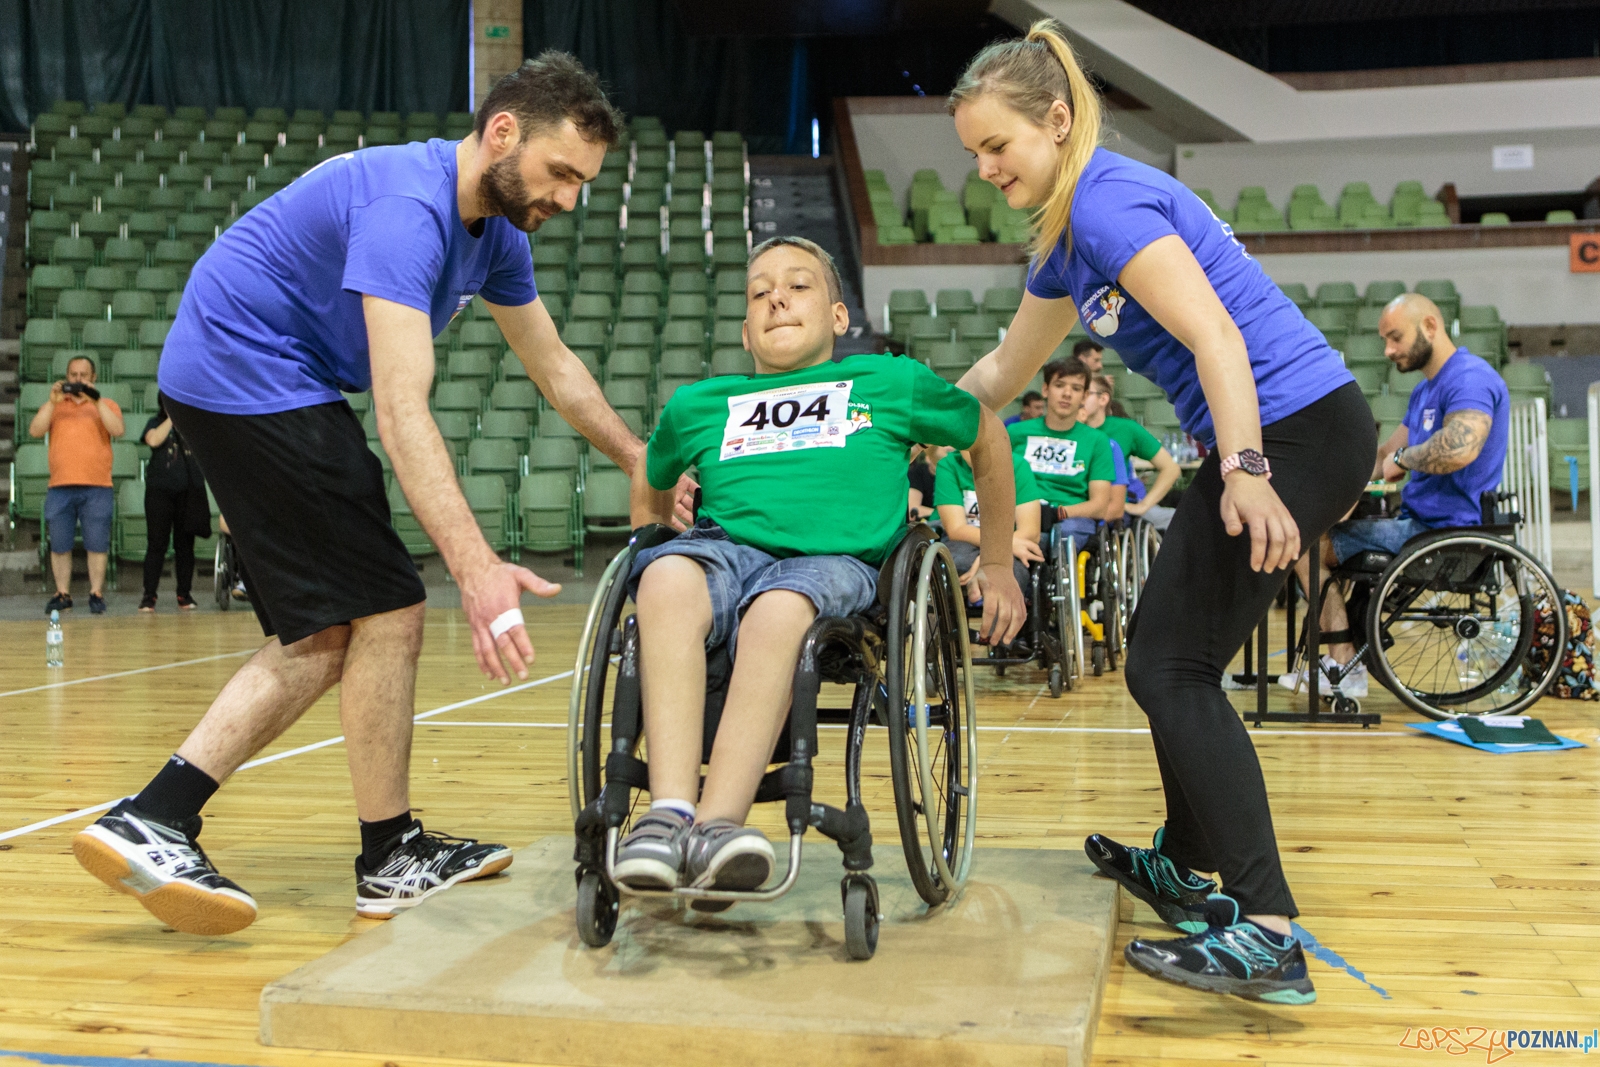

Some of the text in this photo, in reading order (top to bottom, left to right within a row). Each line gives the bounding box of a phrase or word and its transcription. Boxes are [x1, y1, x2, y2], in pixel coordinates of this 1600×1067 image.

[1578, 241, 1599, 264] C
[849, 326, 864, 339] 7
[740, 394, 831, 430] 404
